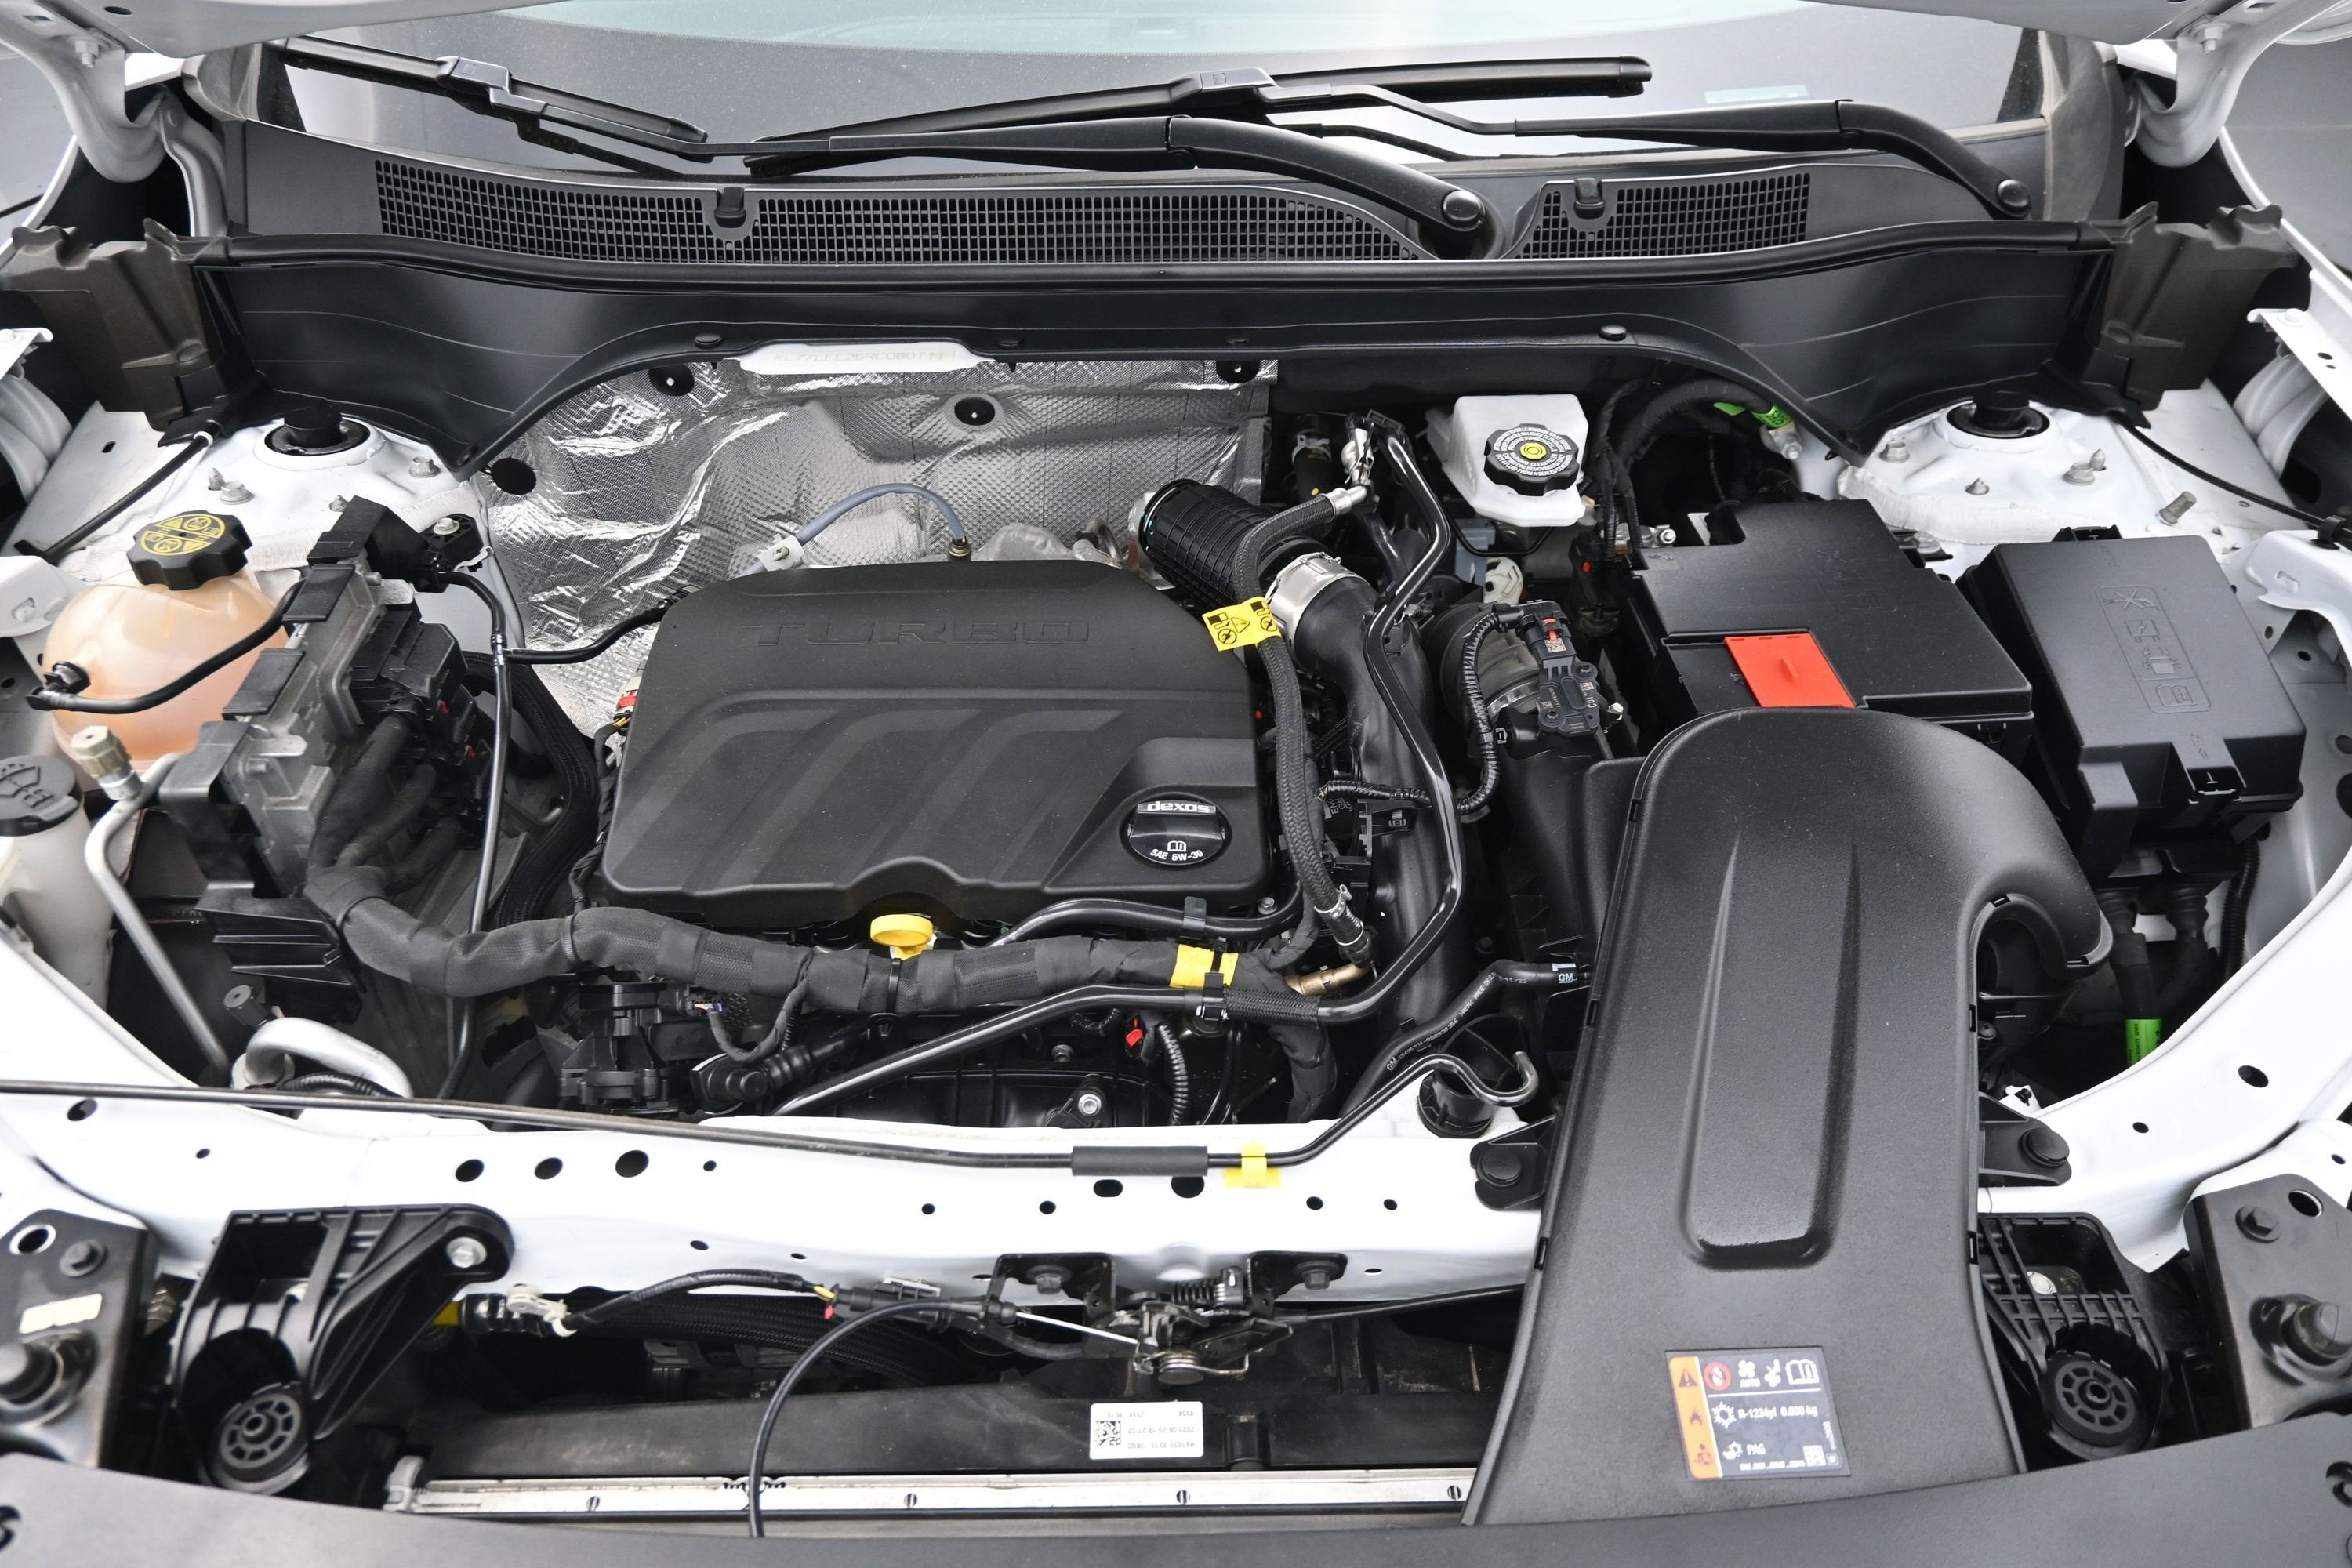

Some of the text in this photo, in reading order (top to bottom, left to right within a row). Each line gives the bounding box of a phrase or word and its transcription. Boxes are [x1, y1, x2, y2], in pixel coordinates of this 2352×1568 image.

[741, 621, 1090, 647] TURBO
[1147, 801, 1210, 812] dexos
[1150, 848, 1203, 861] SAE 5W-30
[1558, 973, 1573, 982] GM
[1746, 1444, 1766, 1455] PAG
